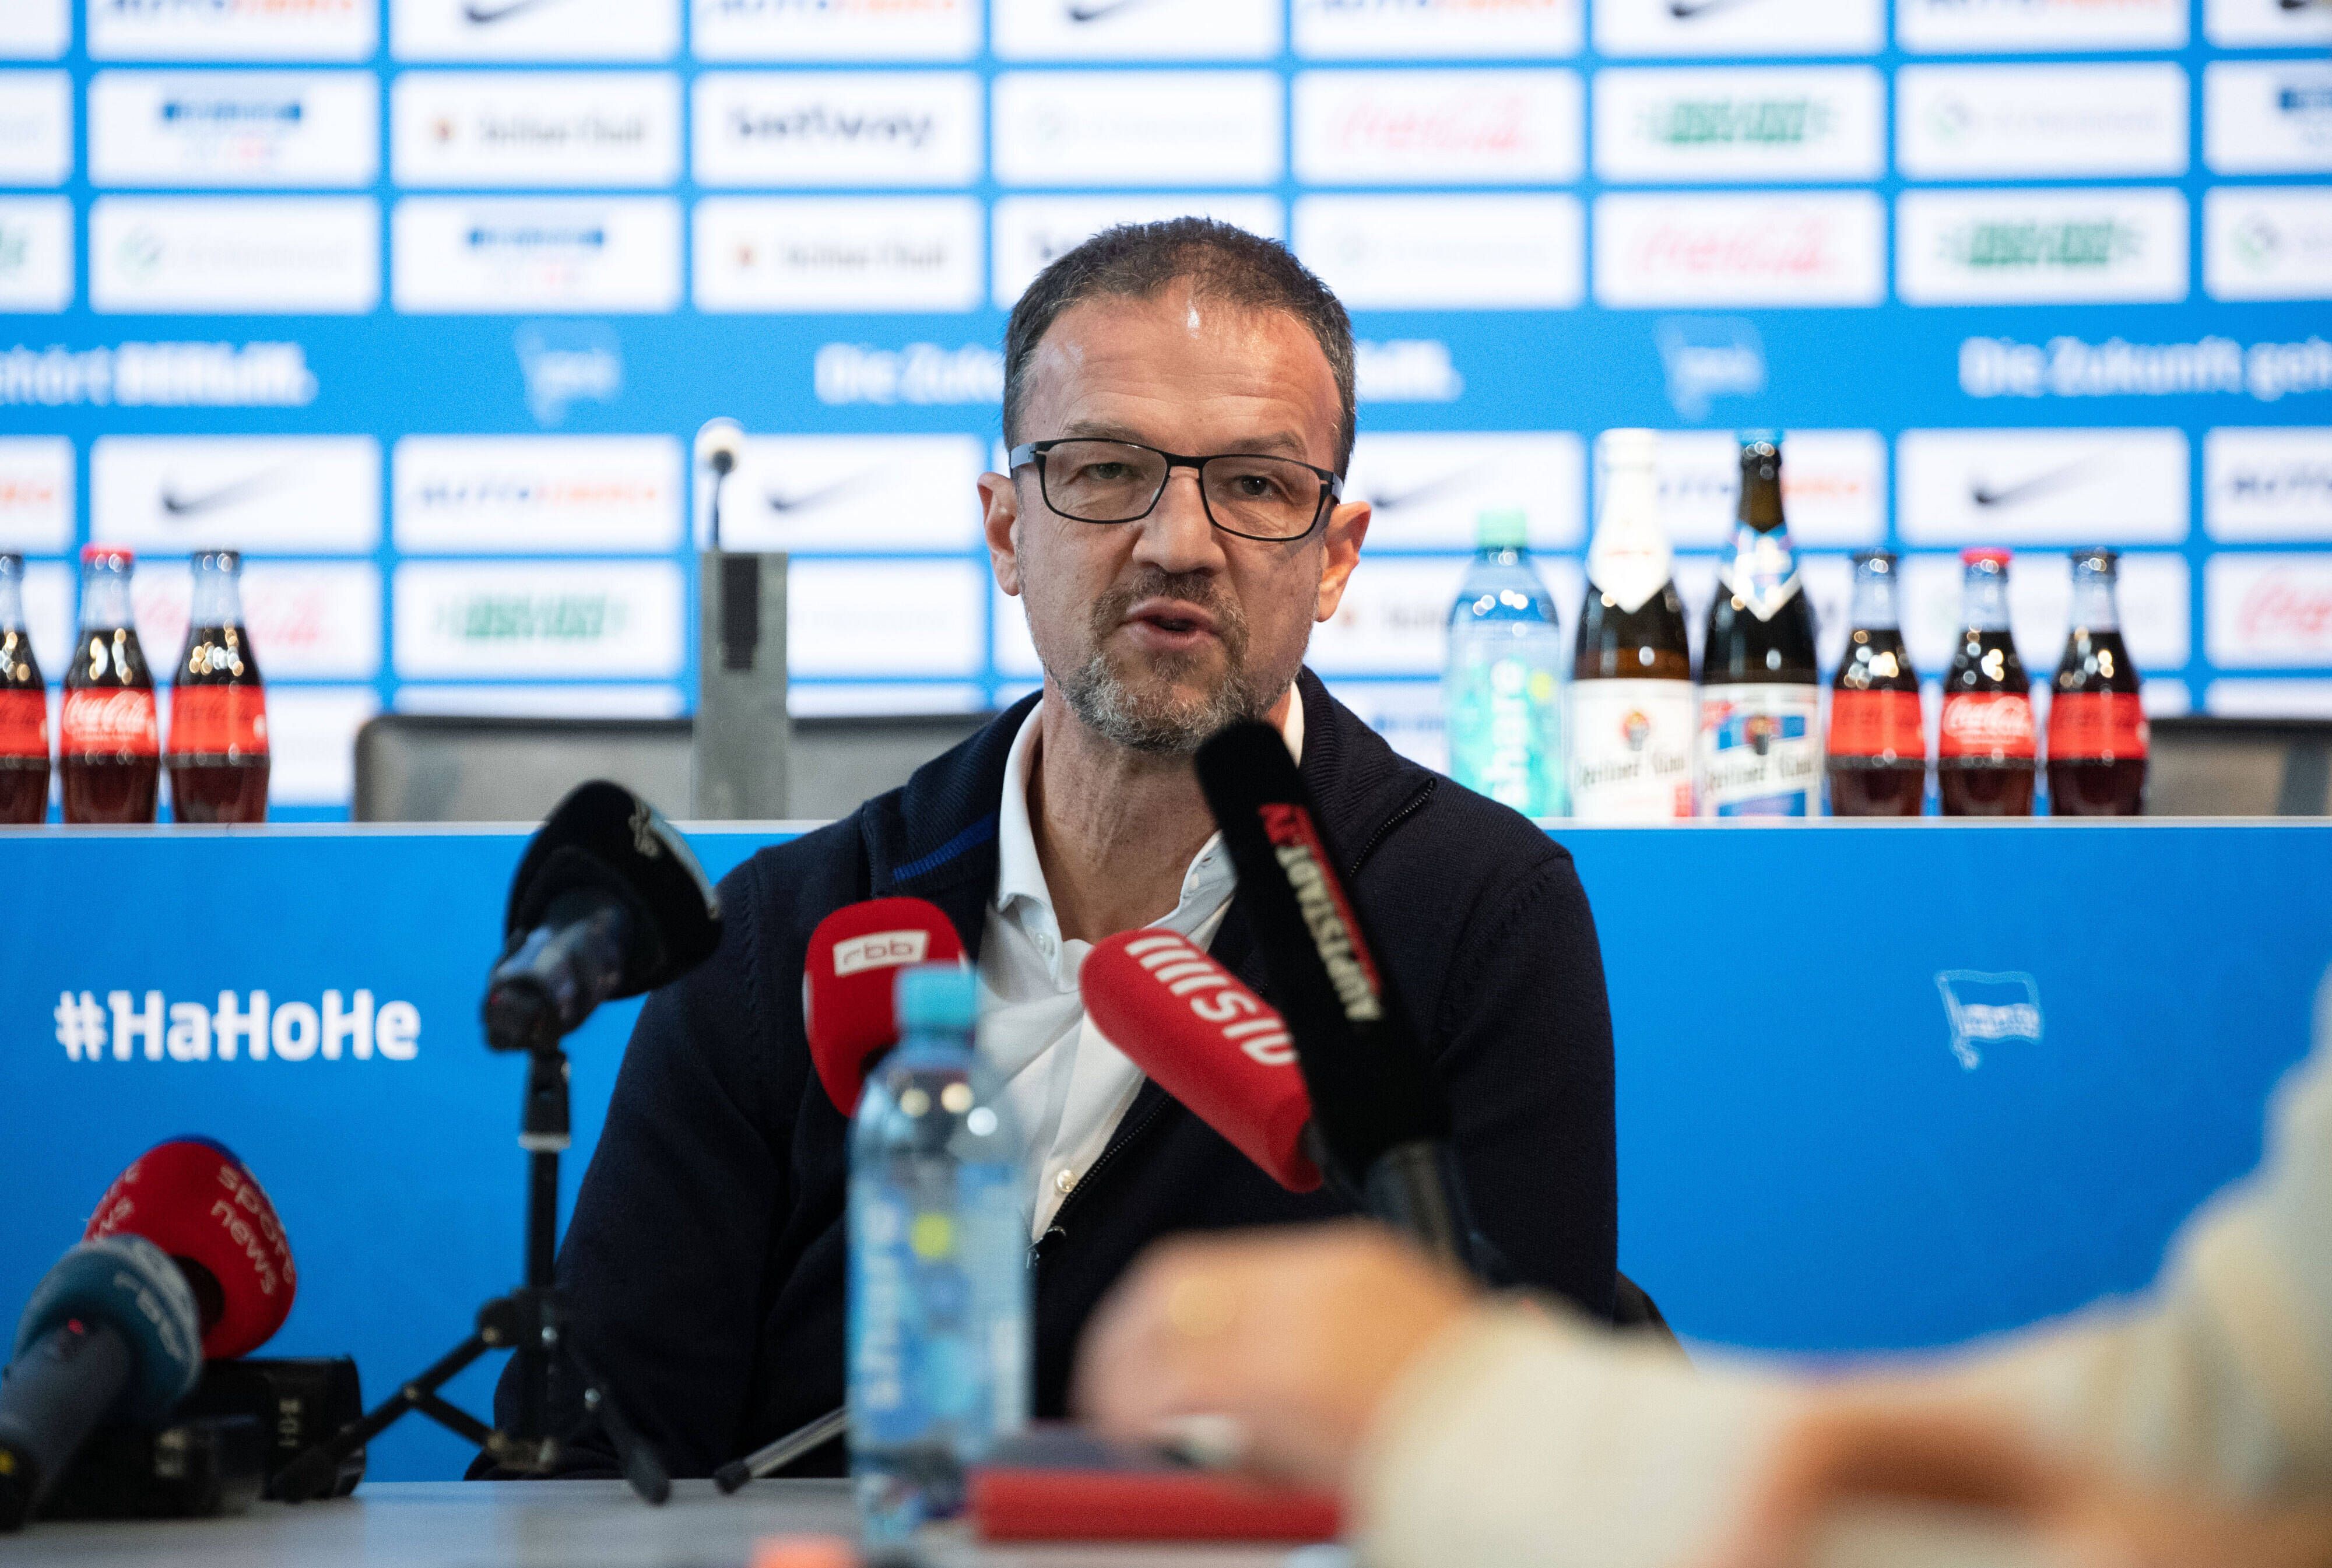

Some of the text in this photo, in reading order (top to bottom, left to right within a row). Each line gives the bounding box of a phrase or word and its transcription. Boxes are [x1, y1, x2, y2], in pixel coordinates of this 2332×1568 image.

[843, 938, 914, 966] rbb
[54, 989, 422, 1062] #HaHoHe
[210, 1198, 278, 1296] news
